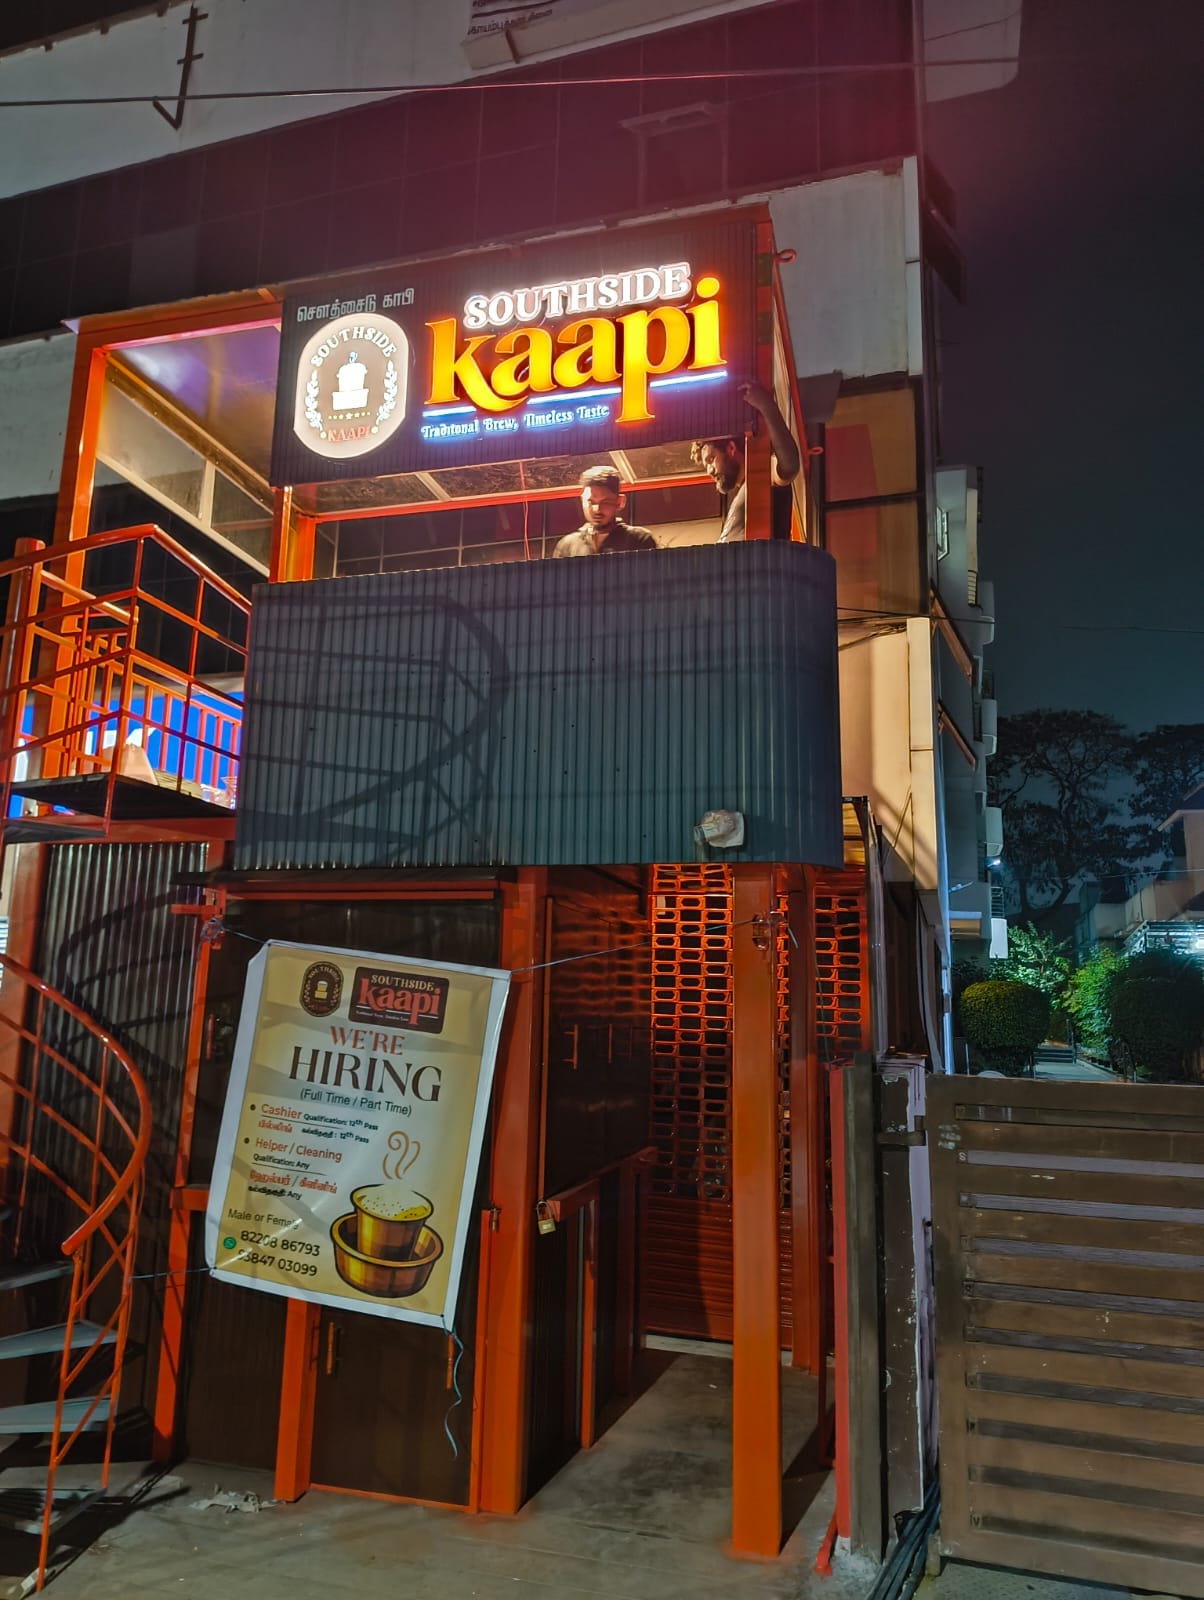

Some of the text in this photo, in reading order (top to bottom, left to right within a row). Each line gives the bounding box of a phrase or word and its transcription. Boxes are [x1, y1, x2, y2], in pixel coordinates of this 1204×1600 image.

[382, 287, 415, 308] காபி
[464, 264, 691, 329] SOUTHSIDE
[310, 326, 398, 368] SOUTHSIDE
[423, 276, 728, 423] kaapi
[483, 417, 518, 431] Brew,
[524, 410, 573, 427] Timeless
[576, 405, 609, 419] Taste
[327, 425, 371, 443] KAAPI
[371, 974, 435, 992] SOUTHSIDE
[358, 977, 442, 1025] kaapi
[330, 1025, 406, 1056] WE'RE
[289, 1046, 443, 1103] HIRING
[261, 1103, 302, 1120] Cashier
[300, 1088, 325, 1104] (Full
[326, 1092, 350, 1106] Time
[360, 1097, 382, 1111] Part
[383, 1100, 413, 1117] Time)
[255, 1137, 288, 1153] Helper
[296, 1144, 343, 1163] Cleaning
[296, 1160, 310, 1170] Any
[287, 1190, 302, 1201] Any
[227, 1208, 252, 1221] Male
[254, 1213, 264, 1222] or
[240, 1230, 321, 1257] 82208 86793
[278, 1258, 318, 1277] 03099
